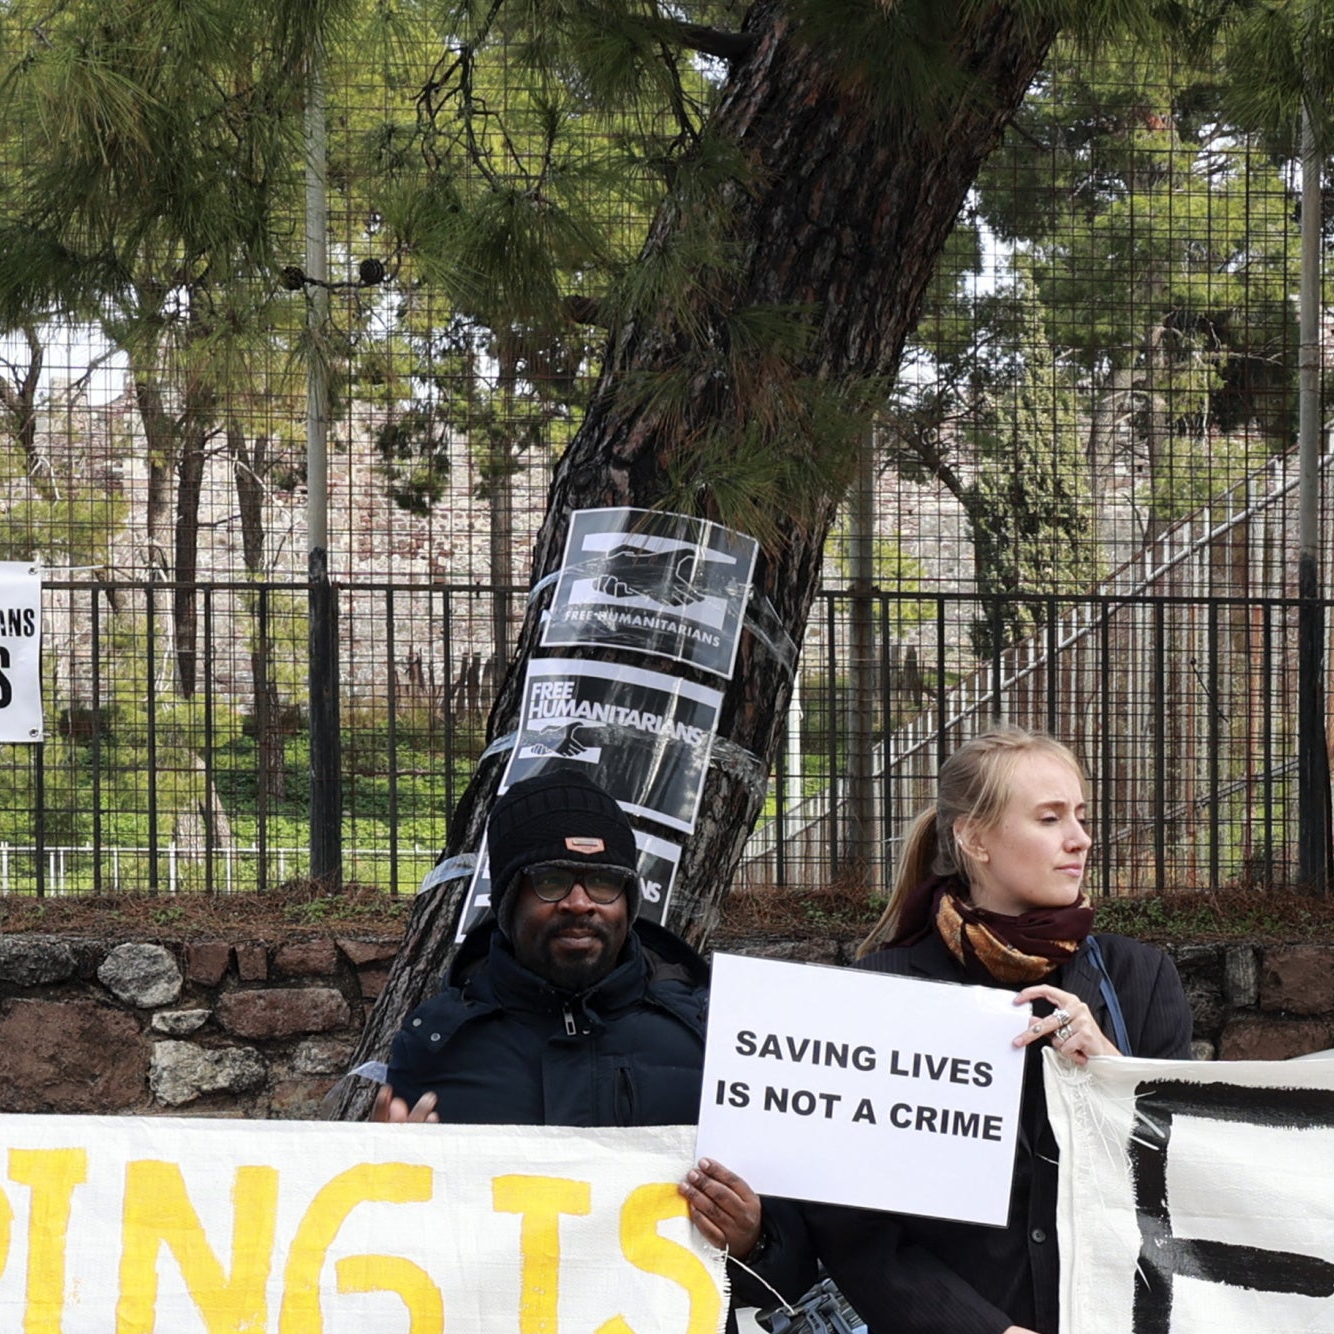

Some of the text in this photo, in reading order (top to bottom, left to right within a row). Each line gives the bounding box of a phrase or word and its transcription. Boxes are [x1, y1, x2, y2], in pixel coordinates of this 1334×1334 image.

[565, 610, 721, 648] FREE HUMANITARIANS
[531, 681, 575, 700] FREE
[528, 698, 704, 746] HUMANITARIANS
[735, 1030, 994, 1087] SAVING LIVES
[715, 1080, 1004, 1142] IS NOT A CRIME
